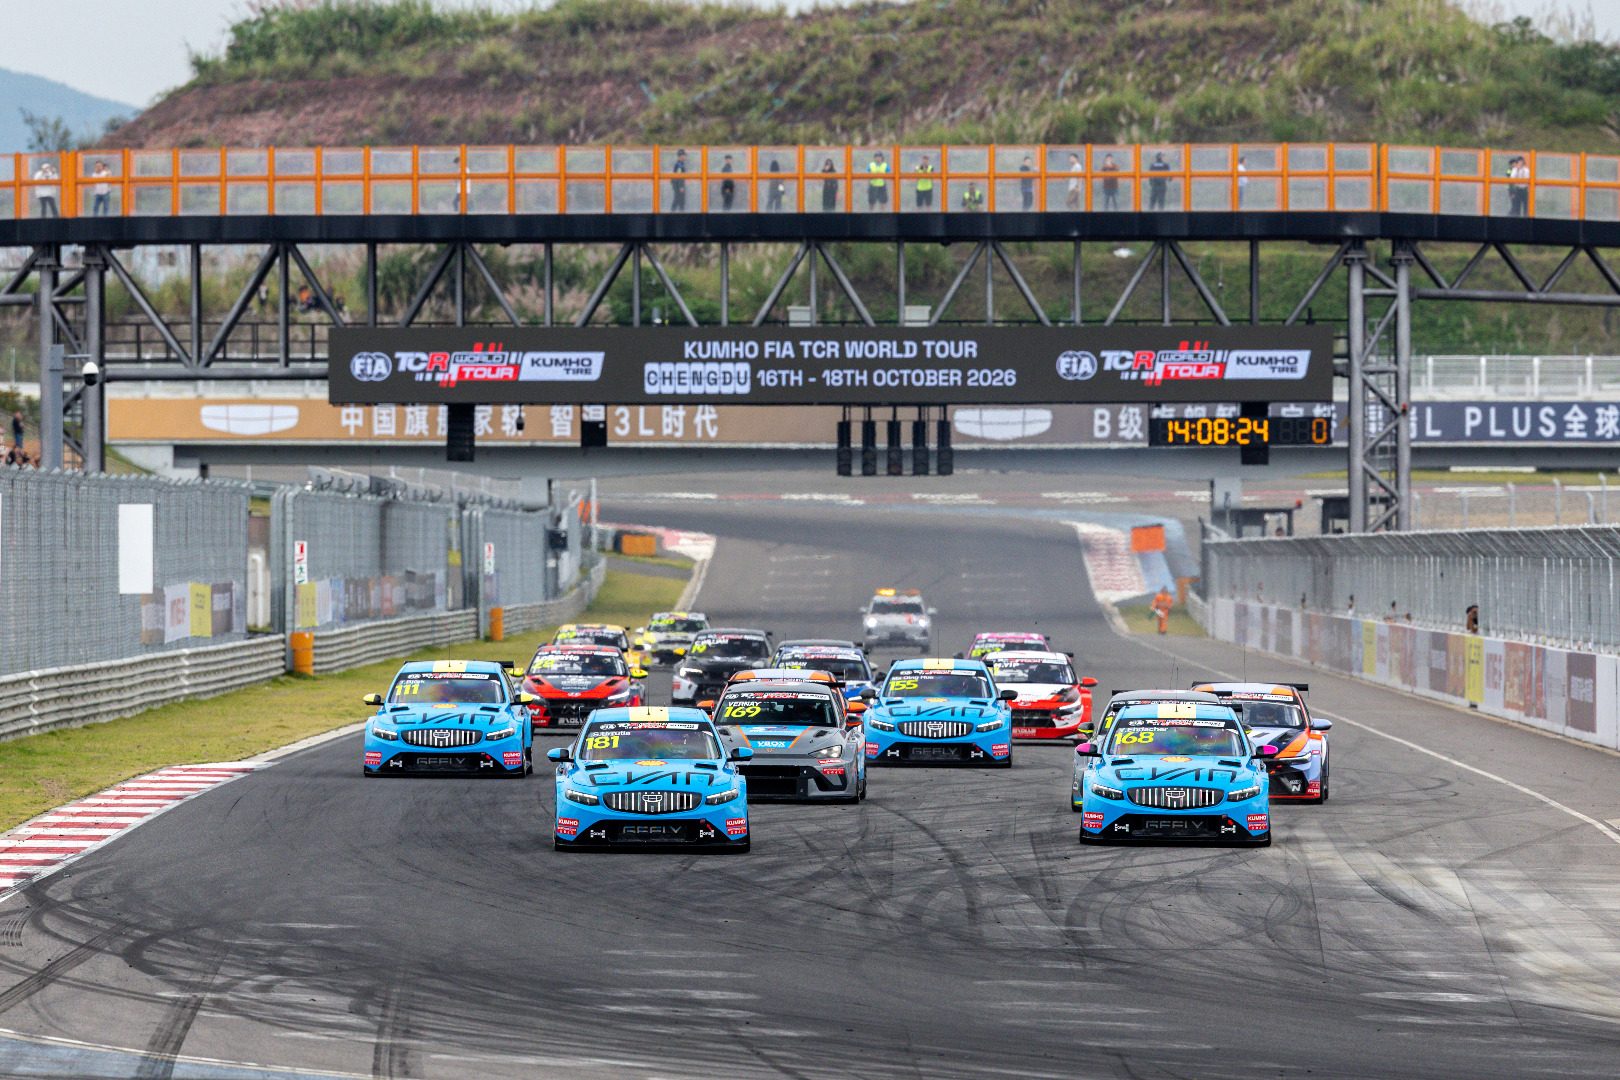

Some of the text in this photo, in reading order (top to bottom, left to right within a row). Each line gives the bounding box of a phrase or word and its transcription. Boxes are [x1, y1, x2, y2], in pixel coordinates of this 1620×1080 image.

[685, 340, 978, 359] KUMHO FIA TCR WORLD TOUR
[394, 352, 450, 371] TCR
[455, 354, 503, 364] WORLD
[531, 357, 592, 367] KUMHO
[1100, 350, 1155, 370] TCR
[1160, 352, 1209, 363] WORLD
[1236, 355, 1298, 366] KUMHO
[353, 357, 389, 376] FIA
[1059, 355, 1094, 376] FIA
[1167, 365, 1220, 377] TOUR
[1270, 366, 1298, 374] TIRE
[462, 366, 514, 379] TOUR
[564, 368, 592, 376] TIRE
[646, 371, 750, 386] CHENGDU
[756, 368, 803, 387] 16TH
[821, 368, 868, 387] 18TH
[872, 368, 963, 387] OCTOBER
[966, 368, 1017, 387] 2026
[1167, 418, 1269, 444] 14:08:24
[1312, 419, 1327, 443] 0
[395, 684, 419, 696] 111
[889, 679, 919, 691] 155
[724, 706, 761, 718] 169
[586, 735, 620, 750] 181
[1115, 731, 1154, 745] 168
[558, 818, 579, 826] KUMHO
